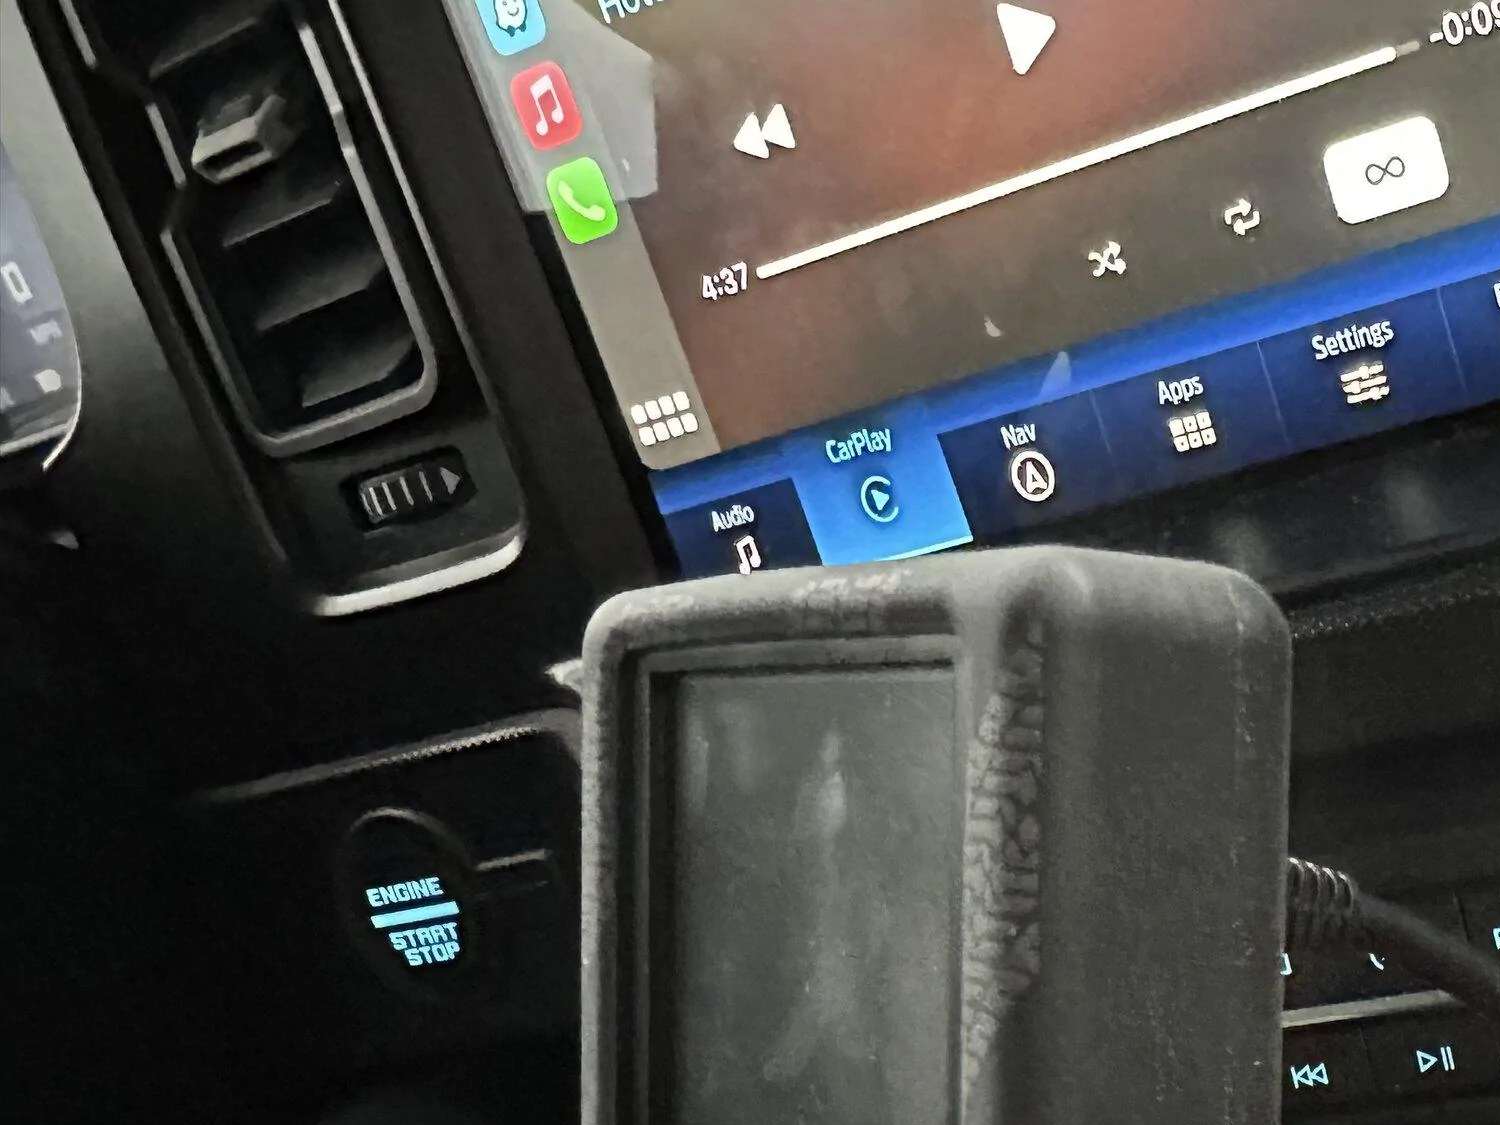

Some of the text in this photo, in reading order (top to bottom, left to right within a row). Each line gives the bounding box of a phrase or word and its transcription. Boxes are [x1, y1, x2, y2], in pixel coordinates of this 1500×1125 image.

[701, 262, 748, 300] 4:37
[1311, 319, 1394, 361] Settings
[1157, 375, 1204, 405] Apps
[825, 427, 892, 465] CarPlay
[1000, 423, 1036, 450] Nav
[711, 504, 755, 532] Audio
[366, 876, 443, 907] ENGINE
[388, 922, 458, 950] START
[404, 941, 461, 966] STOP
